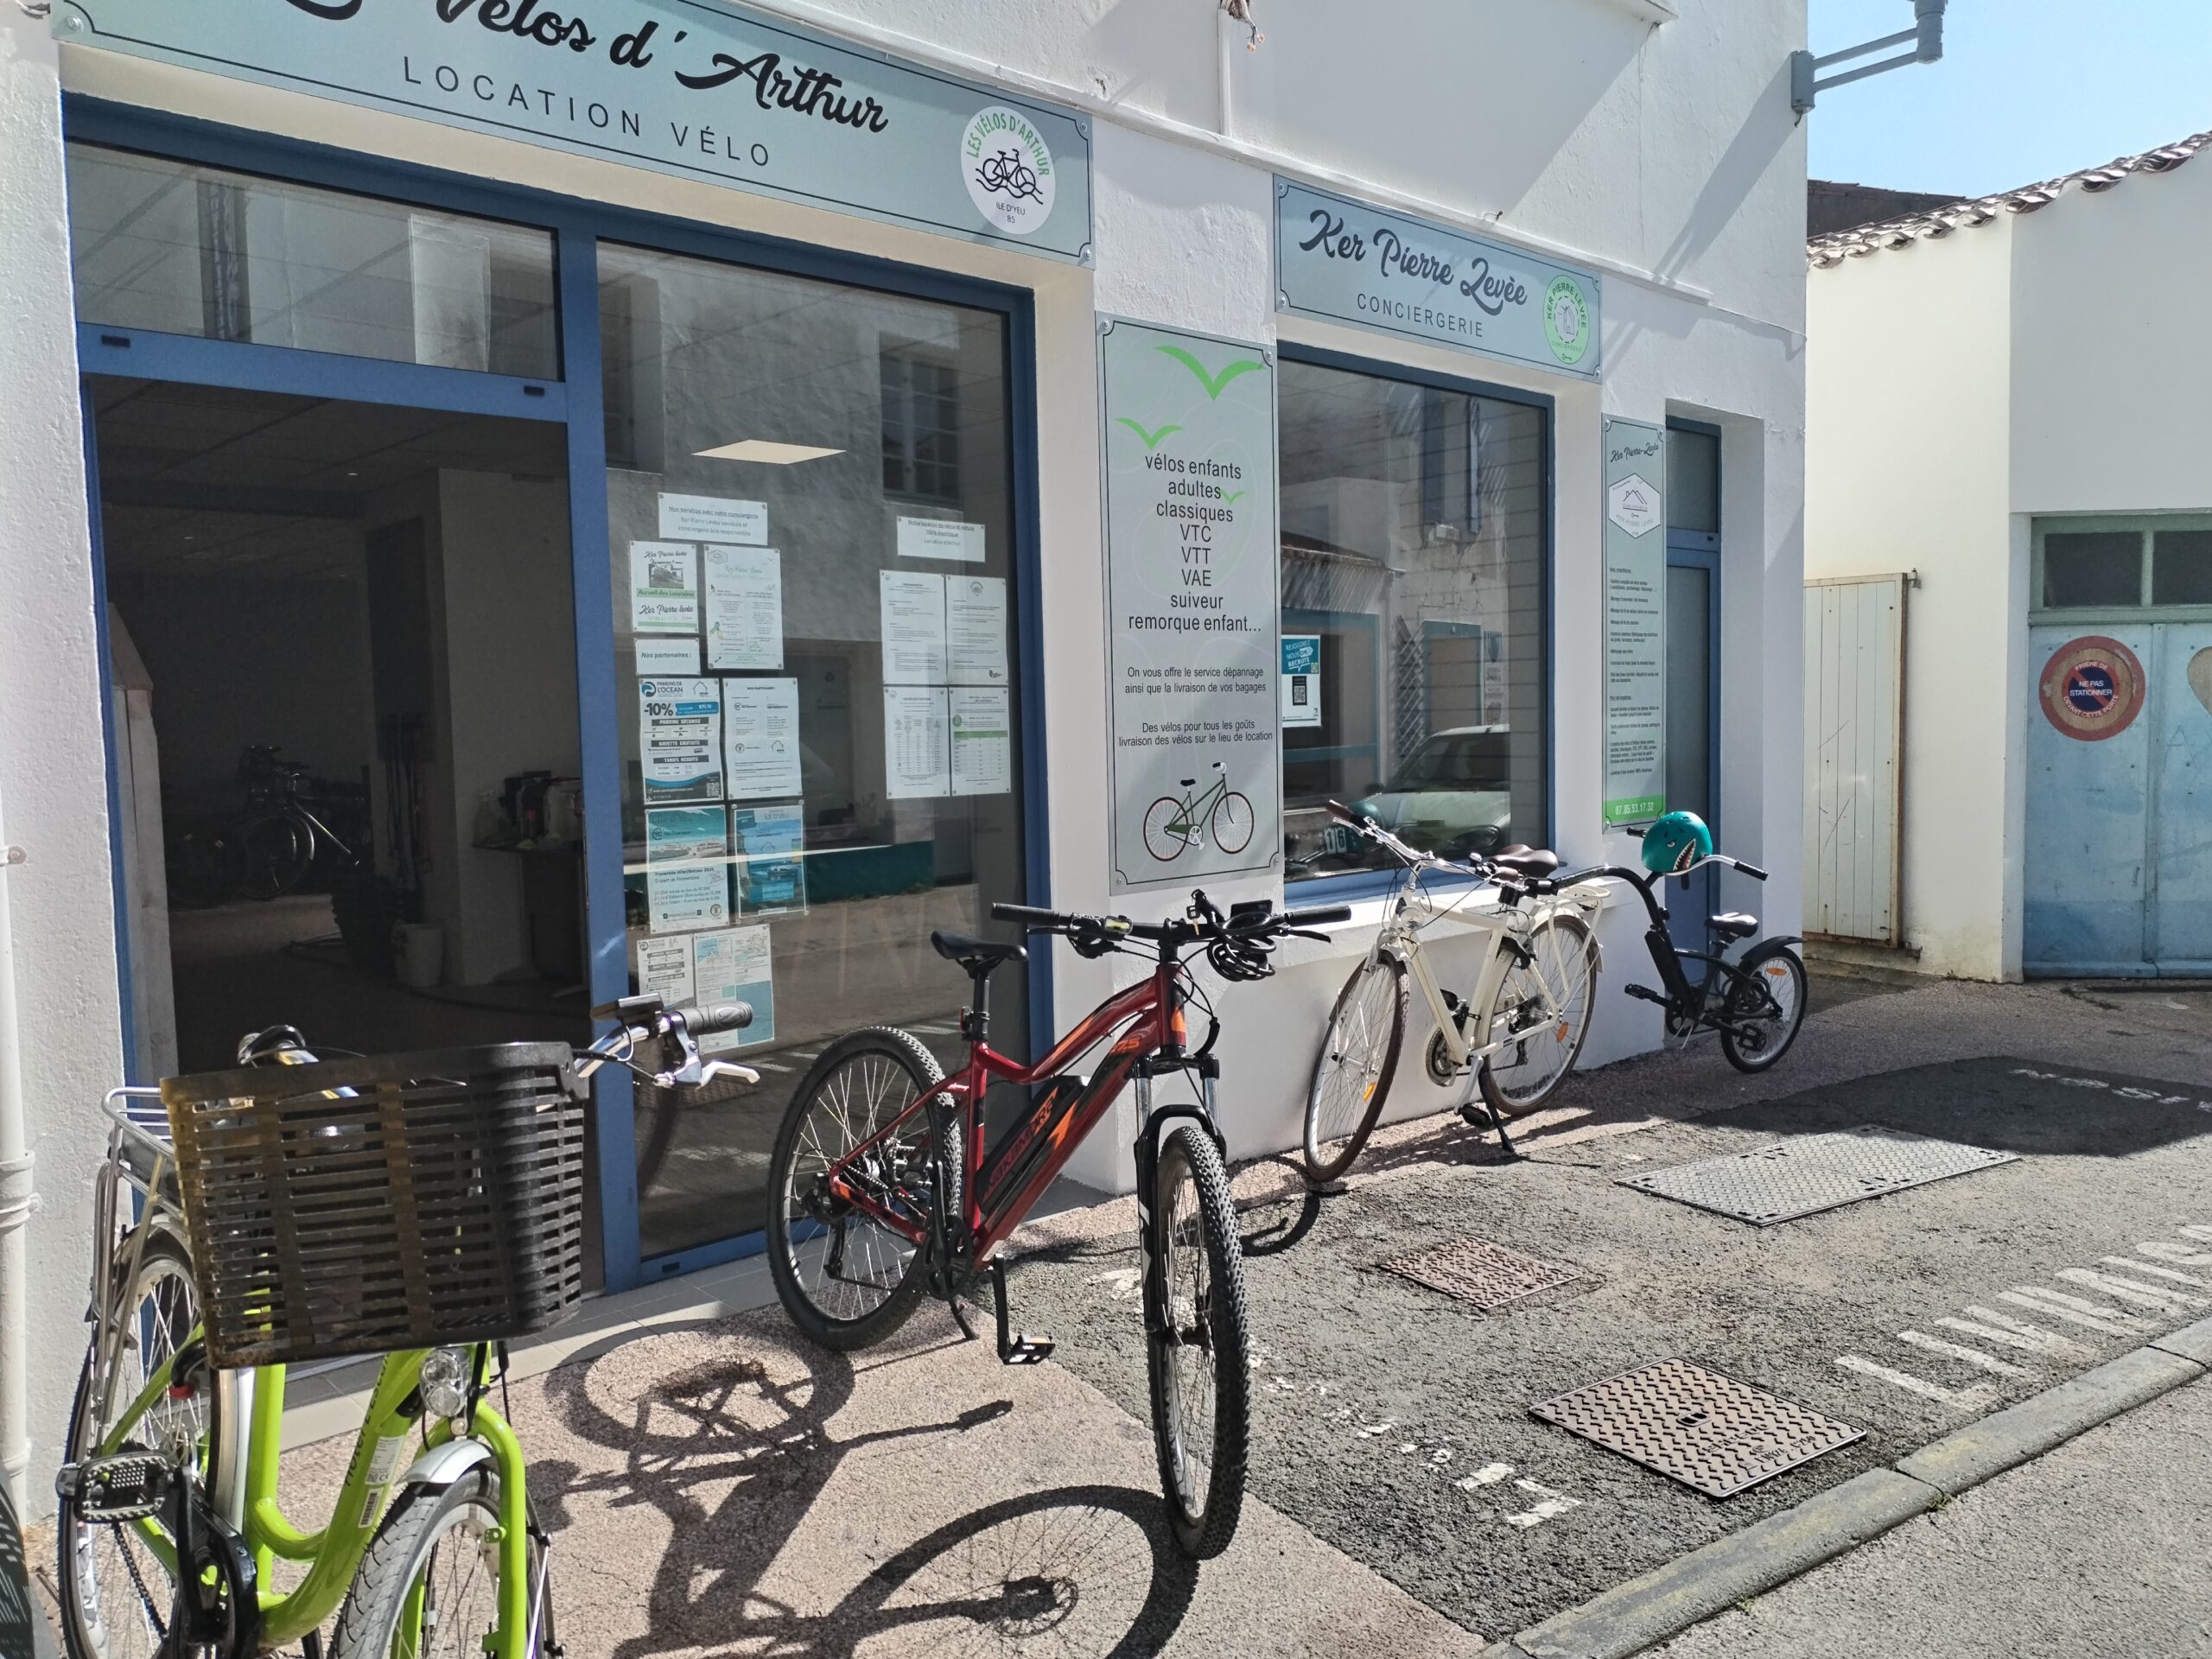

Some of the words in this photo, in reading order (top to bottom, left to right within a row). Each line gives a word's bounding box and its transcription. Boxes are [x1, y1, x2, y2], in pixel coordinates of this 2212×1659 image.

[404, 56, 641, 137] LOCATION
[671, 122, 769, 166] VÉLO
[966, 133, 982, 158] LES
[975, 112, 1007, 137] VÉLOS
[995, 202, 1005, 211] ILE
[1006, 204, 1026, 216] D'YEU
[1007, 214, 1015, 224] 85
[1299, 209, 1366, 261] Ker
[1373, 228, 1454, 285] Pierre
[1552, 282, 1574, 296] PIERRE
[1357, 293, 1483, 337] CONCIERGERIE
[1146, 453, 1185, 473] vélos
[1189, 460, 1242, 480] enfants
[1168, 479, 1222, 499] adultes
[1156, 499, 1233, 524] classiques
[1180, 524, 1211, 543] VTC
[1181, 546, 1211, 564] VTT
[1182, 569, 1211, 587] VAE
[1171, 592, 1224, 609] suiveur
[1128, 615, 1200, 634] remorque
[1204, 615, 1262, 632] enfant...
[1286, 640, 1311, 652] REJOIGNEZ
[1287, 652, 1300, 660] NOUS
[1288, 657, 1310, 668] RECRUTE
[1128, 667, 1140, 677] On
[1142, 668, 1162, 677] vous
[1165, 667, 1182, 677] offre
[1185, 667, 1192, 677] le
[1194, 668, 1221, 677] service
[1224, 667, 1263, 681] dépannage
[1125, 683, 1144, 693] ainsi
[1147, 684, 1162, 695] que
[1165, 683, 1172, 693] la
[1173, 683, 1205, 693] livraison
[1208, 683, 1217, 692] de
[1236, 683, 1267, 694] bagages
[645, 703, 674, 716] -10%
[2063, 696, 2082, 716] DEVANT
[2103, 695, 2119, 713] PORTE
[1142, 722, 1159, 733] Des
[1161, 721, 1182, 732] vélos
[1184, 722, 1201, 734] pour
[1204, 721, 1220, 731] tous
[1222, 721, 1233, 730] les
[1236, 720, 1255, 732] goûts
[1119, 736, 1152, 747] livraison
[1154, 735, 1170, 746] des
[1173, 734, 1192, 745] vélos
[1195, 734, 1206, 744] sur
[1210, 733, 1217, 743] le
[1218, 733, 1231, 742] lieu
[1234, 733, 1243, 741] de
[1245, 732, 1273, 741] location
